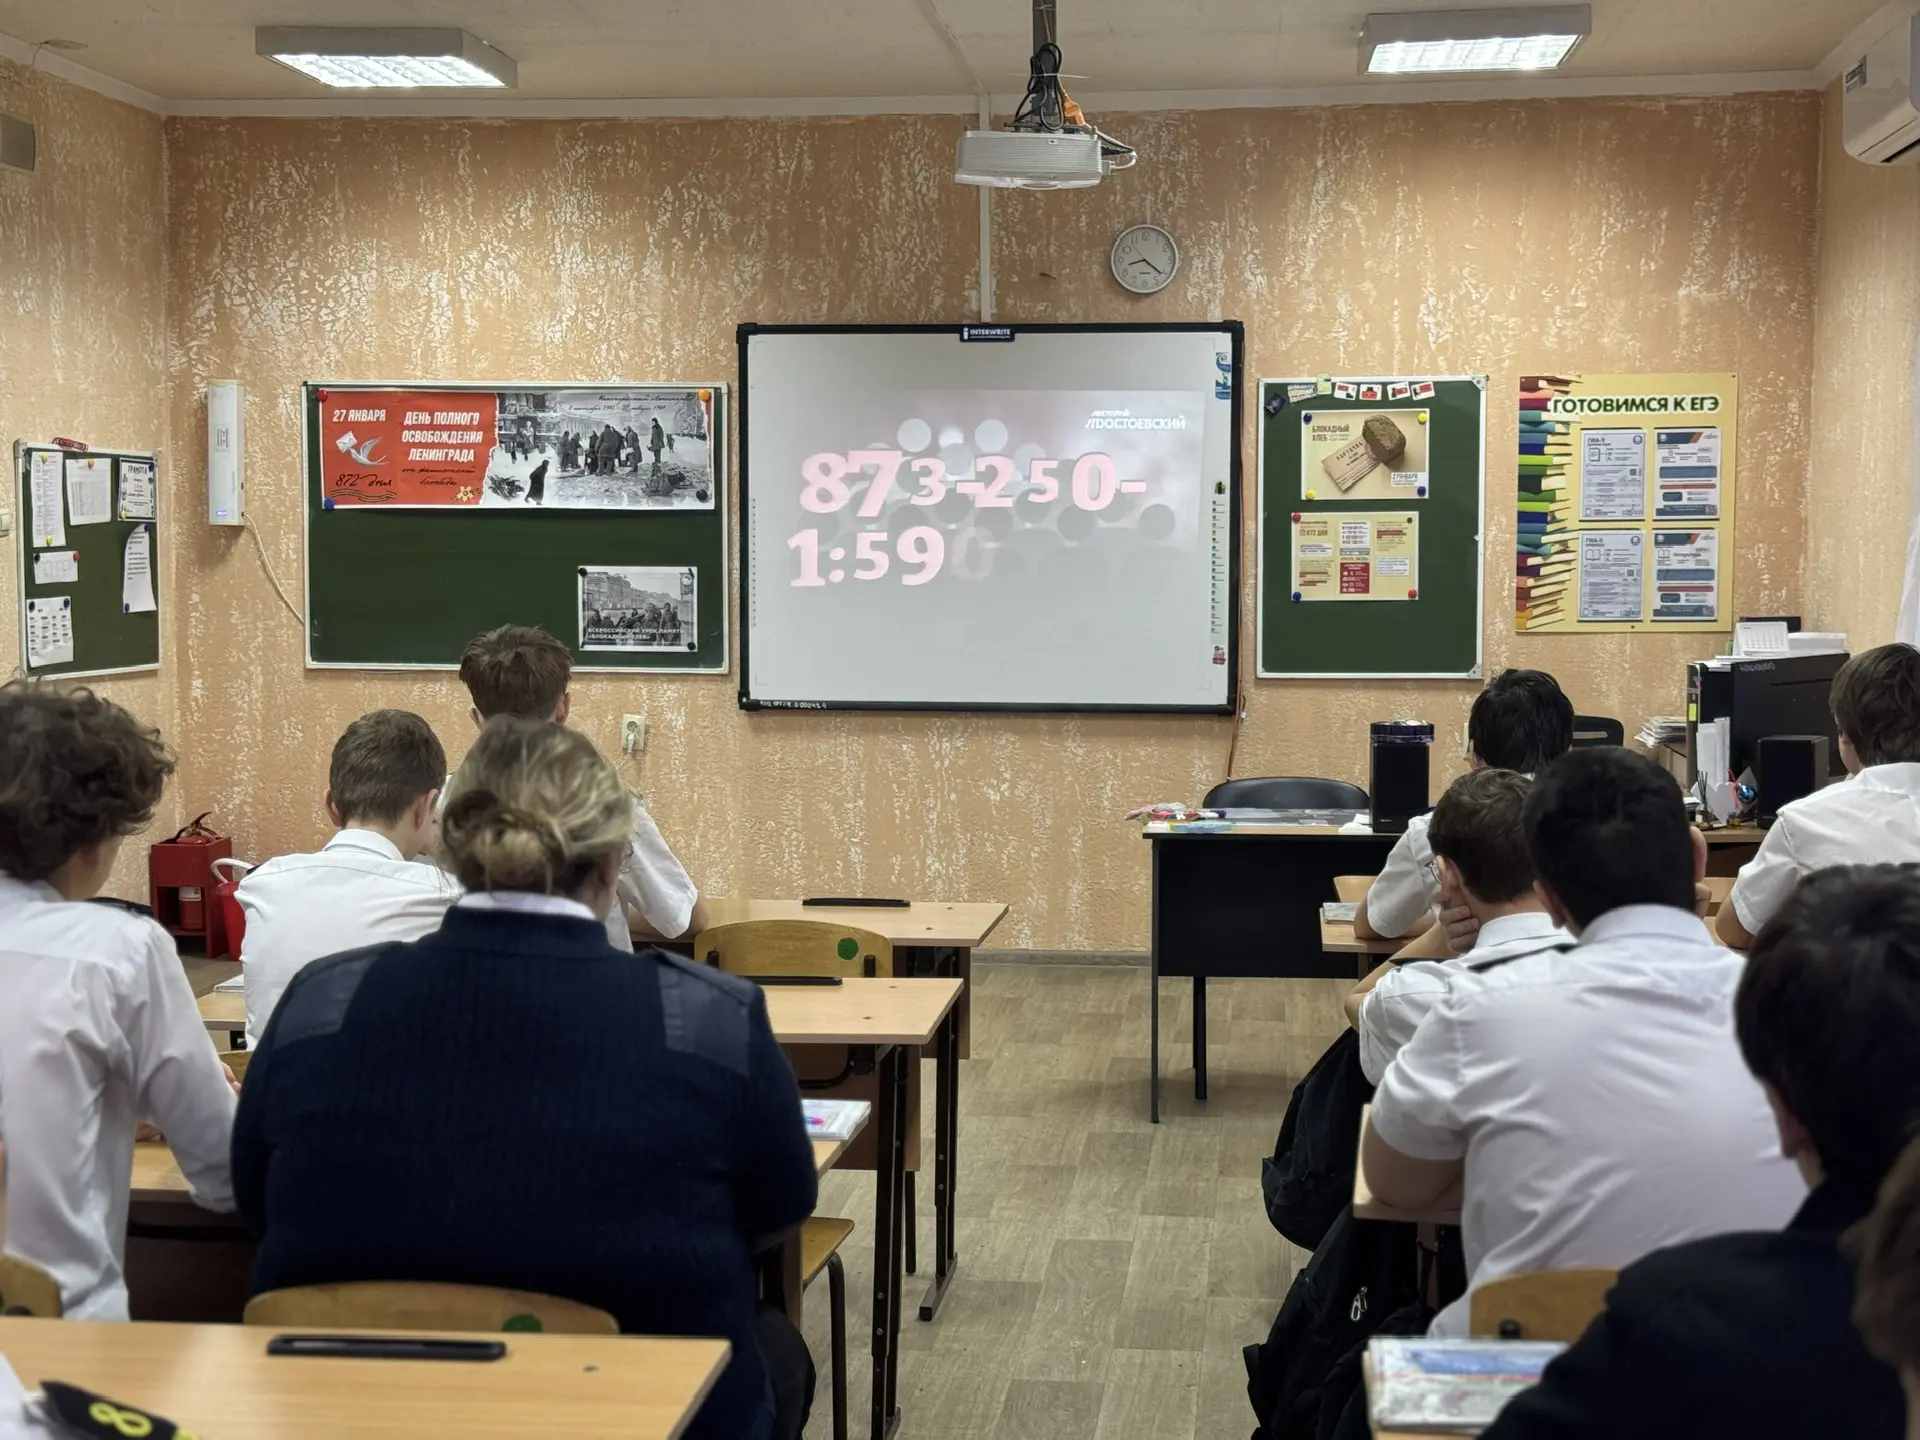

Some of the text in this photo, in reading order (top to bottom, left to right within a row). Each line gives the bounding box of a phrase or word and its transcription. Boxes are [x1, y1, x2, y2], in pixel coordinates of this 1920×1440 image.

[1552, 396, 1720, 413] ГОТОВИМСЯ К ЕГЭ
[332, 409, 387, 422] 27 ЯНВАРЯ
[403, 411, 480, 426] ДЕНЬ ПОЛНОГО
[401, 430, 483, 445] ОСВОБОЖДЕНИЯ
[1312, 434, 1328, 442] ХЛЕБ
[407, 448, 475, 463] ЛЕНИНГРАДА
[336, 474, 392, 487] 872 дня
